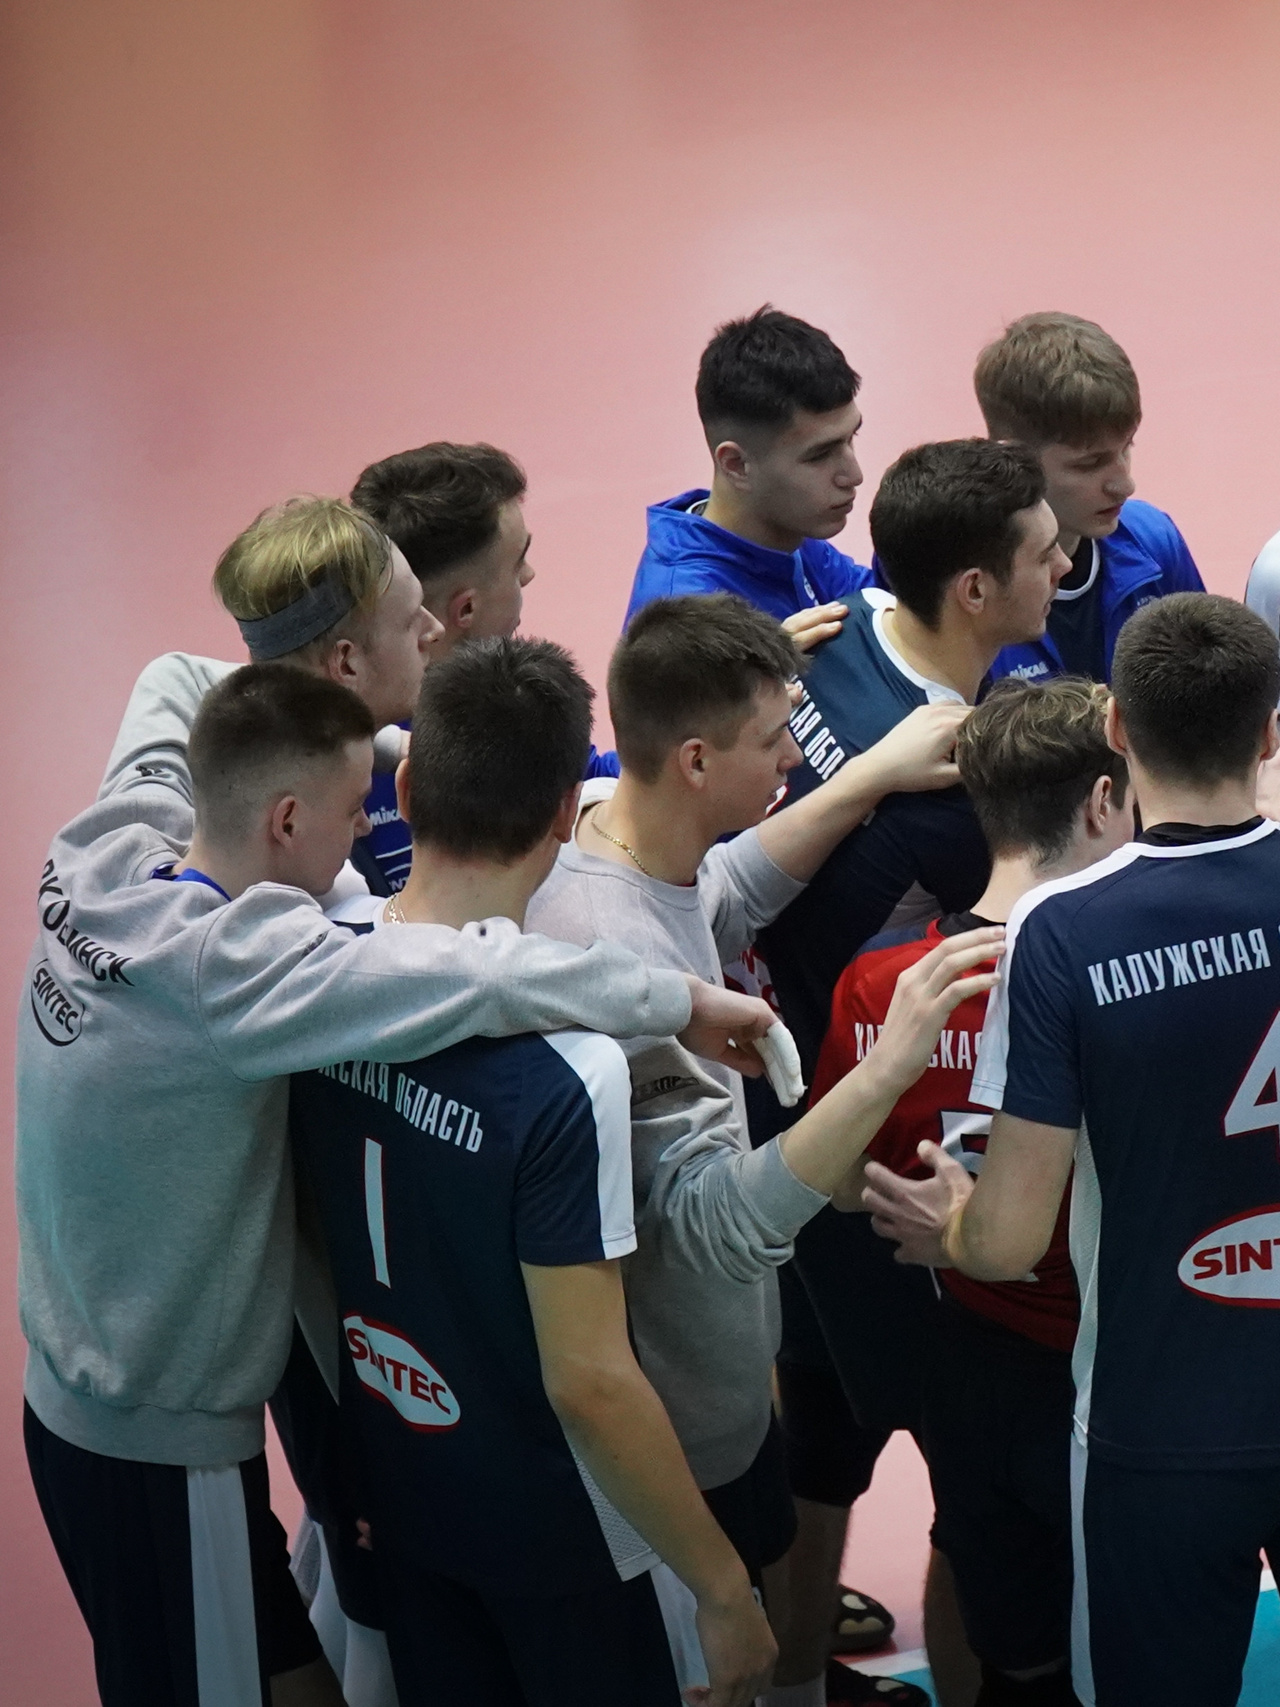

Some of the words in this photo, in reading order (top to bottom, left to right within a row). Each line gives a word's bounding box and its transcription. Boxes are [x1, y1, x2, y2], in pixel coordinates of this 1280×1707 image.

[34, 967, 80, 1035] SINTEC
[1087, 928, 1272, 1006] КАЛУЖСКАЯ
[395, 1072, 484, 1153] ОБЛАСТЬ
[364, 1137, 392, 1290] 1
